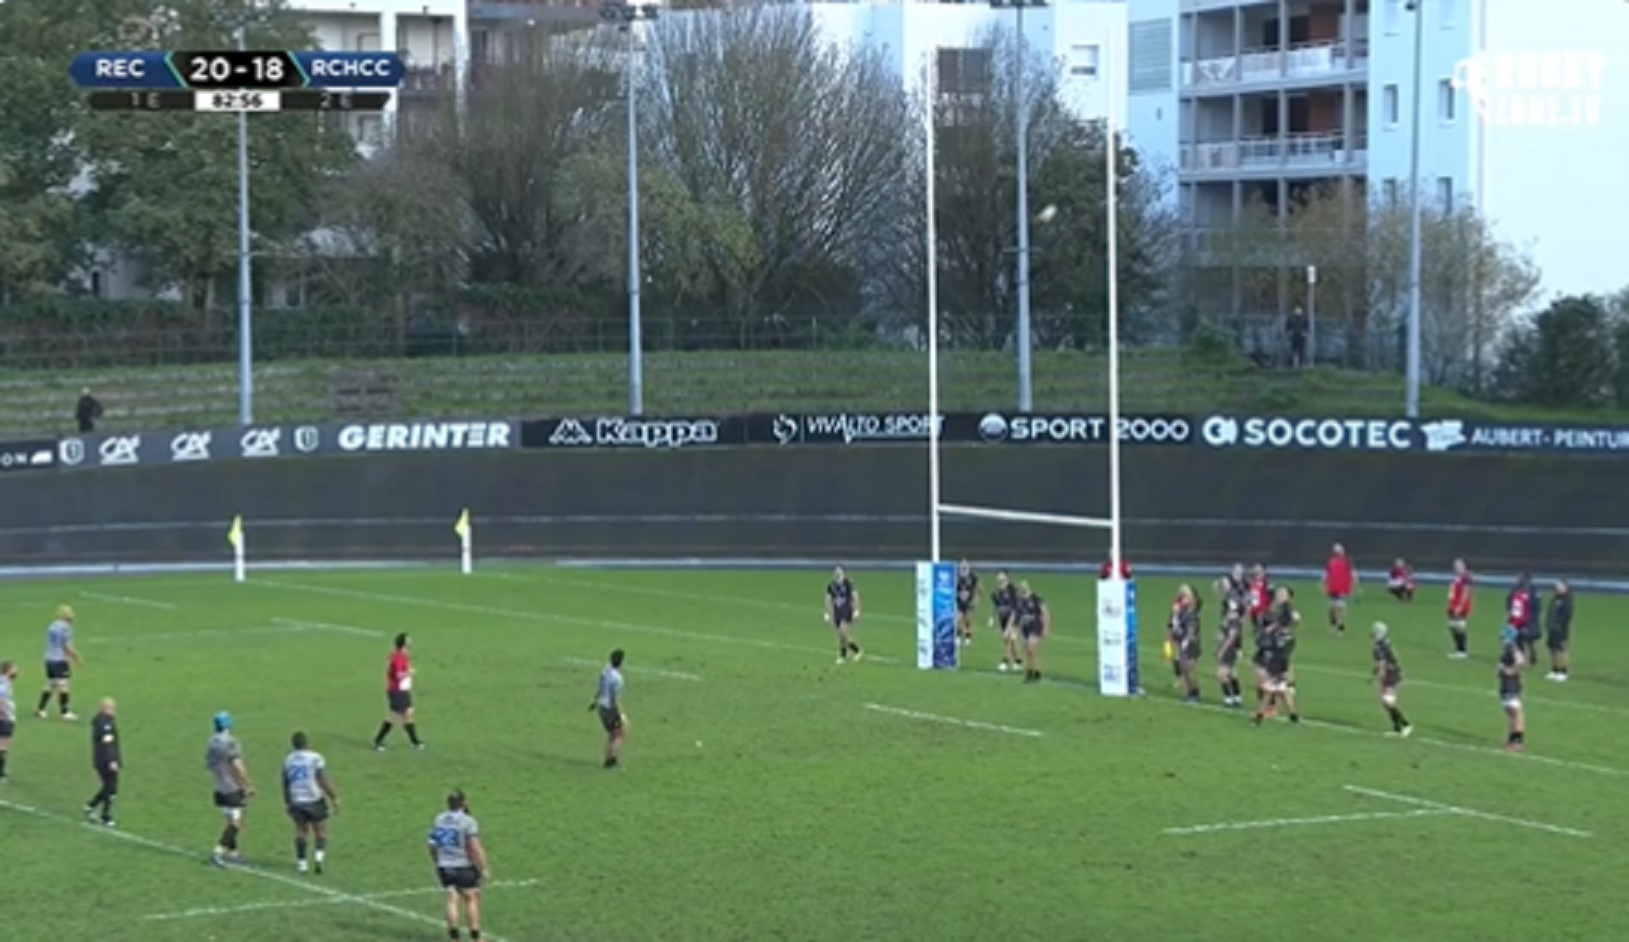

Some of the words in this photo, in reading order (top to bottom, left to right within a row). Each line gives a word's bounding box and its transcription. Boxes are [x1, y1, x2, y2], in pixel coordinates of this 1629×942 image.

[338, 422, 510, 450] GERINTER
[597, 418, 718, 447] Kappa
[807, 413, 879, 444] VIVALTO
[885, 415, 945, 435] SPORT
[1010, 418, 1104, 439] SPORT
[1117, 418, 1189, 440] 2000
[1244, 419, 1411, 448] SOCOTEC
